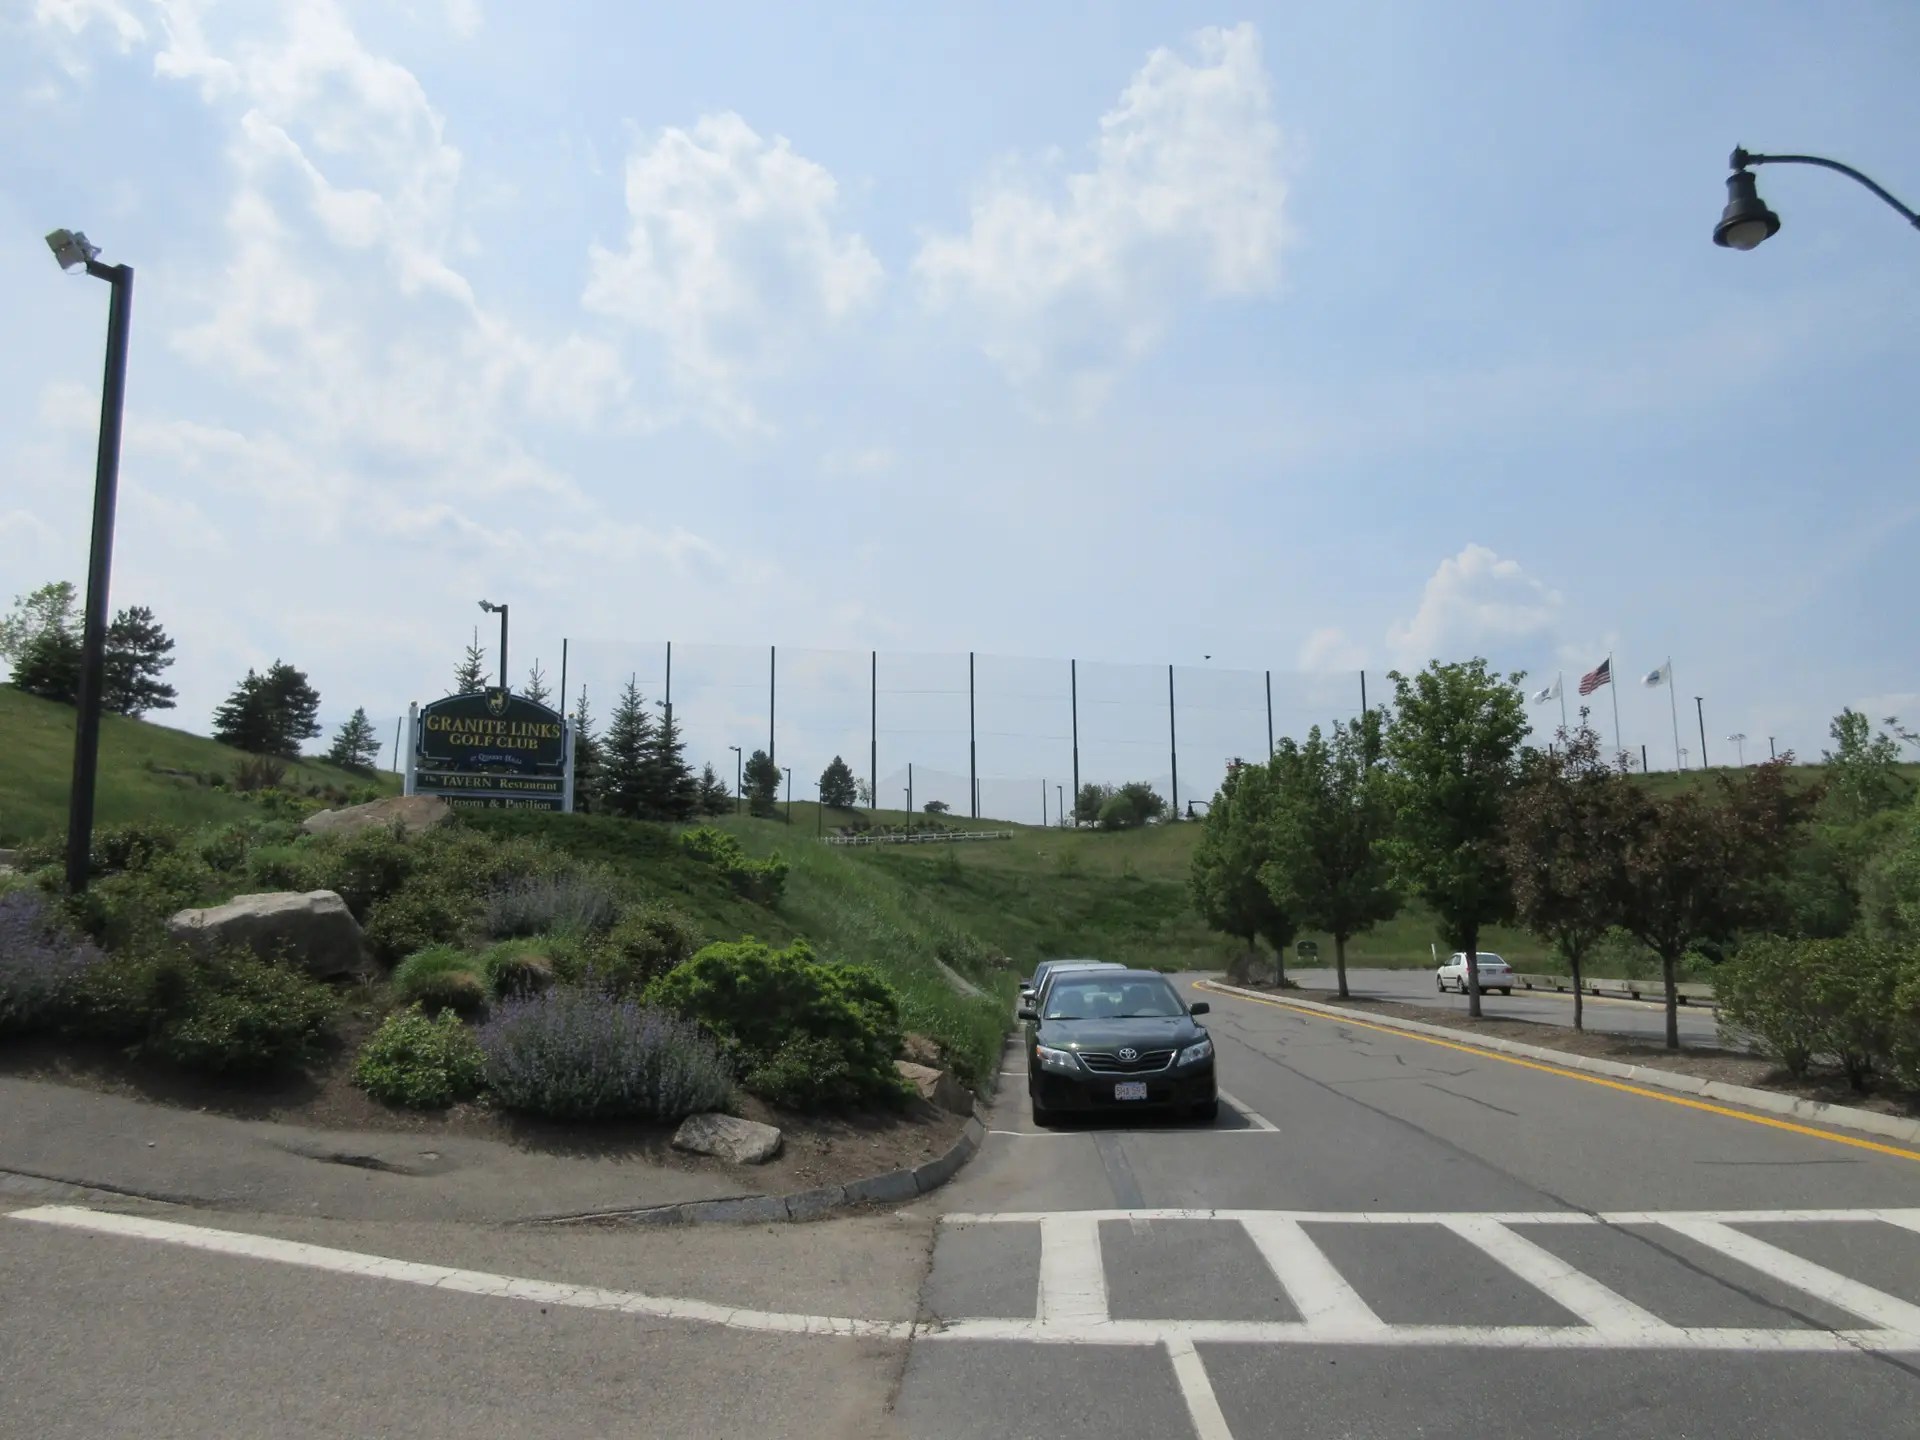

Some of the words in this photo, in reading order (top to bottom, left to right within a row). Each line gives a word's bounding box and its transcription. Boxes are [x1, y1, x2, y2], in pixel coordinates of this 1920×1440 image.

[427, 715, 507, 735] GRANITE
[511, 722, 561, 738] LINKS
[449, 733, 494, 746] GOLF
[496, 736, 538, 749] CLUB
[441, 775, 492, 788] TAVERN
[500, 778, 557, 791] Restaurant
[443, 796, 484, 809] llroom
[488, 799, 500, 809] &
[505, 799, 552, 811] Pavilion
